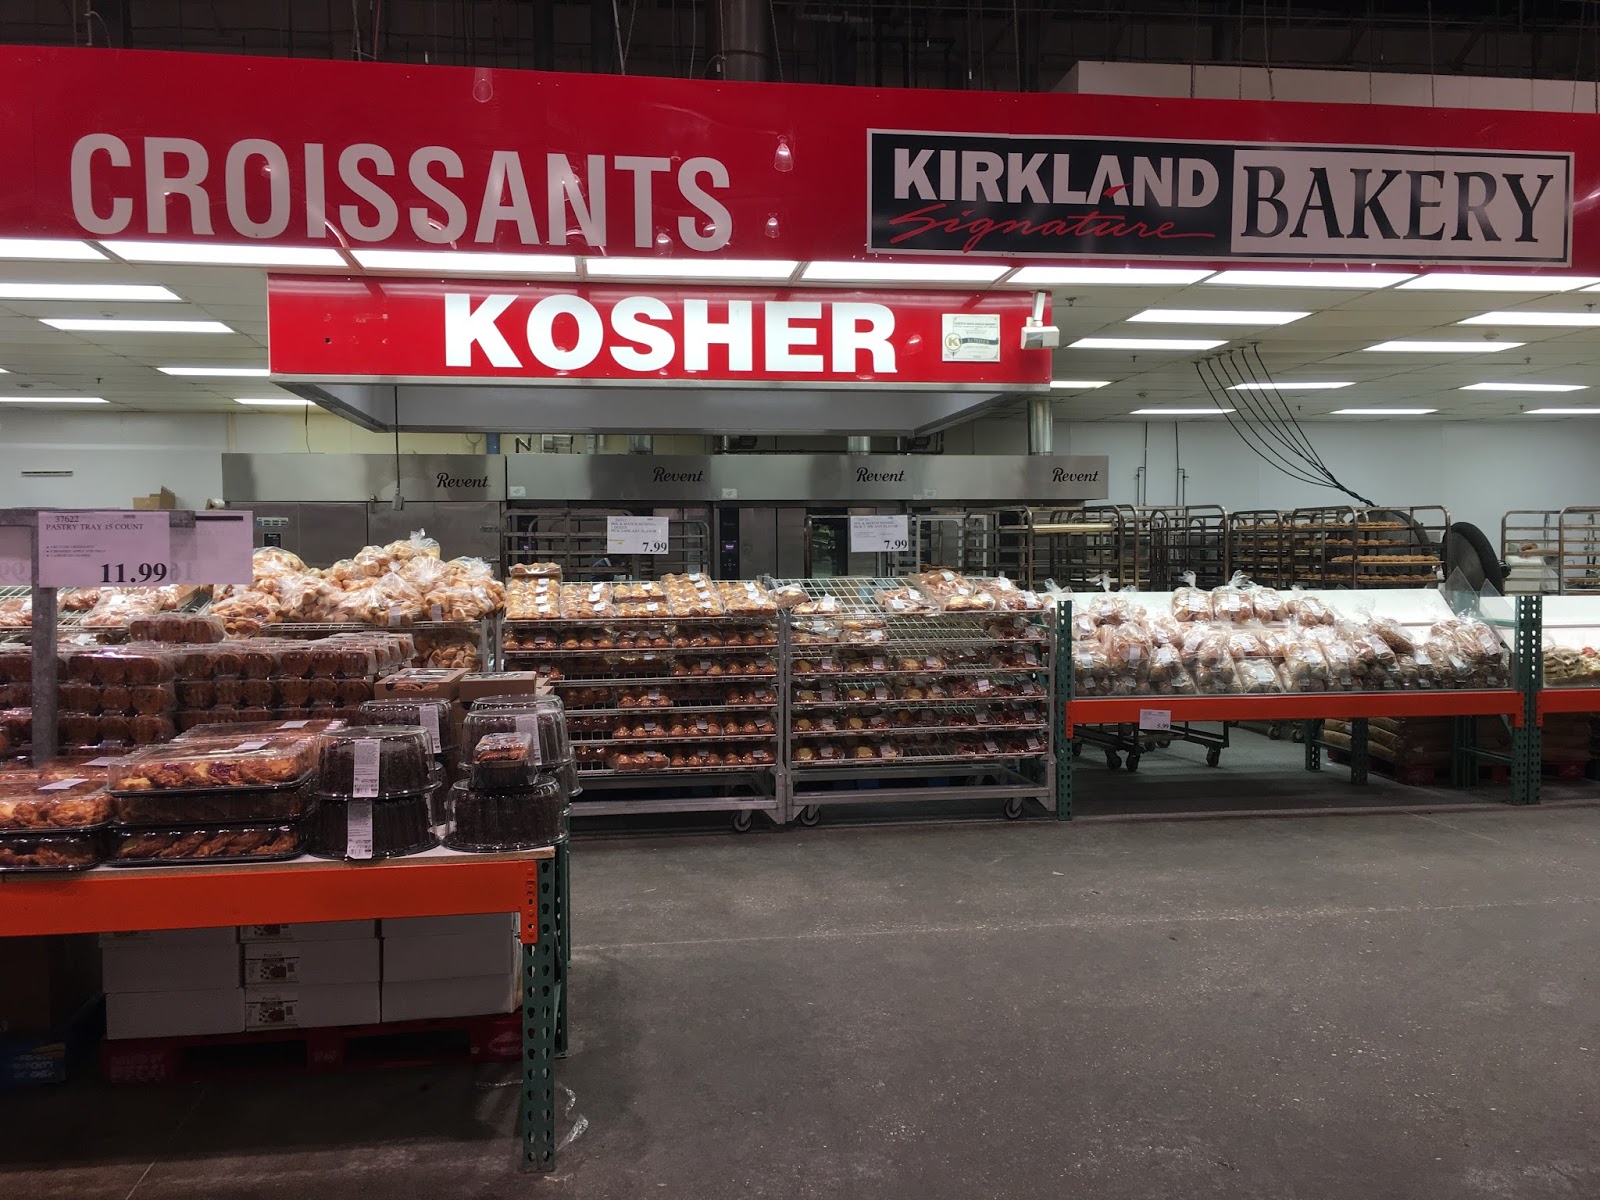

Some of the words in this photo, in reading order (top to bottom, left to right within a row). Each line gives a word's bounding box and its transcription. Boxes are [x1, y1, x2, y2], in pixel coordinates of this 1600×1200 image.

[893, 147, 1220, 208] KIRKLAND
[70, 133, 733, 252] CROISSANTS
[1240, 165, 1554, 243] BAKERY
[889, 203, 1216, 254] Signature
[444, 292, 899, 373] KOSHER
[436, 472, 489, 489] Revent
[652, 466, 703, 484] Revent
[855, 466, 905, 483] Revent
[1052, 467, 1099, 483] Revent
[46, 523, 78, 531] PASTRY
[80, 523, 102, 531] TRAY
[105, 523, 113, 531] 15
[114, 523, 144, 531] COUNT
[54, 515, 79, 523] 37622
[642, 542, 667, 552] 7.99
[884, 540, 908, 550] 7.99
[100, 562, 168, 583] 11.99
